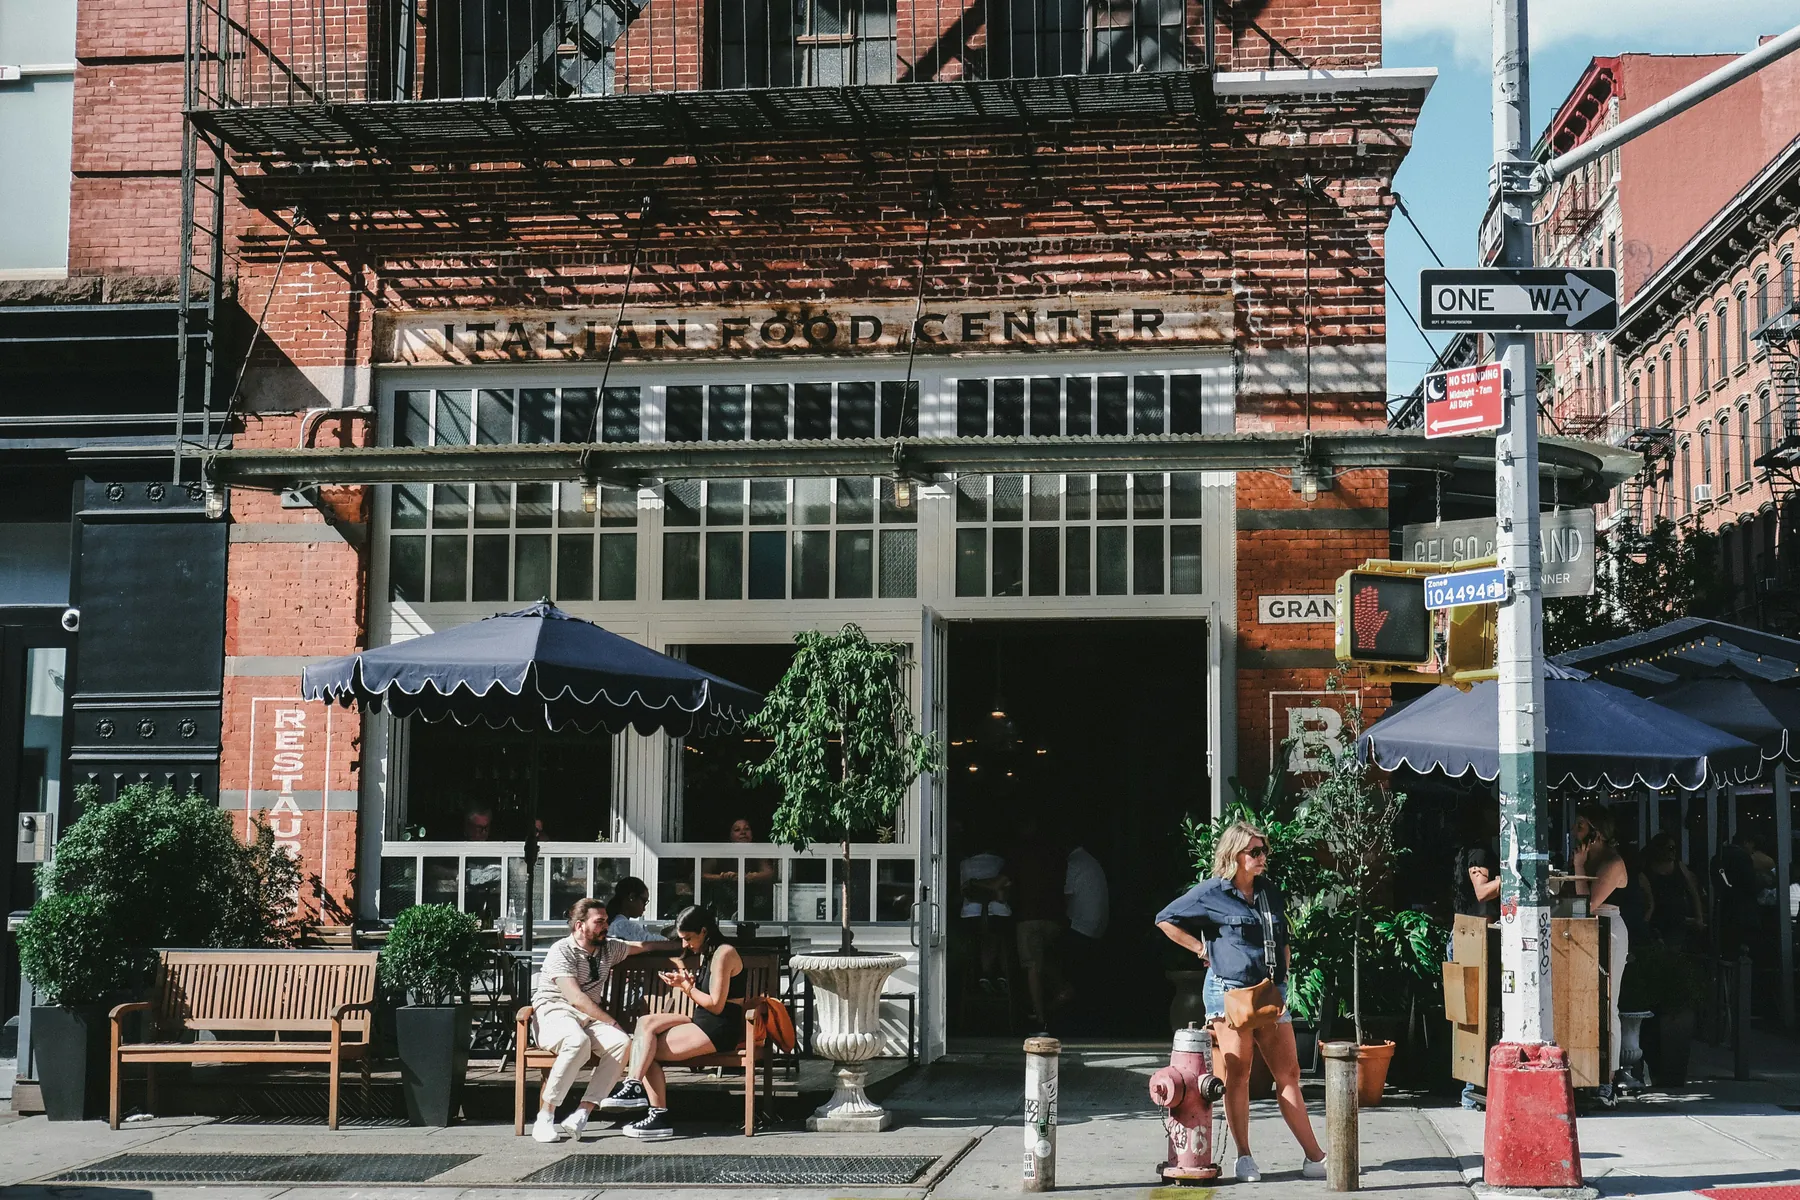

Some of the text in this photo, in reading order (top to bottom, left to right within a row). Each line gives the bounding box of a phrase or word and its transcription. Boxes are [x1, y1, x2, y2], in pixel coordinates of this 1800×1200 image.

[1438, 288, 1590, 312] ONE WAY
[444, 308, 1165, 352] ITALIAN FOOD CENTER
[1449, 369, 1498, 386] NO STANDING
[1449, 387, 1475, 400] Midnight
[1479, 386, 1493, 395] 7am
[1449, 400, 1473, 410] All Days
[1484, 541, 1493, 557] &
[1541, 572, 1571, 585] NNER
[1428, 583, 1486, 606] 104494
[1268, 600, 1336, 618] GRAN
[267, 709, 306, 914] RESTAUR
